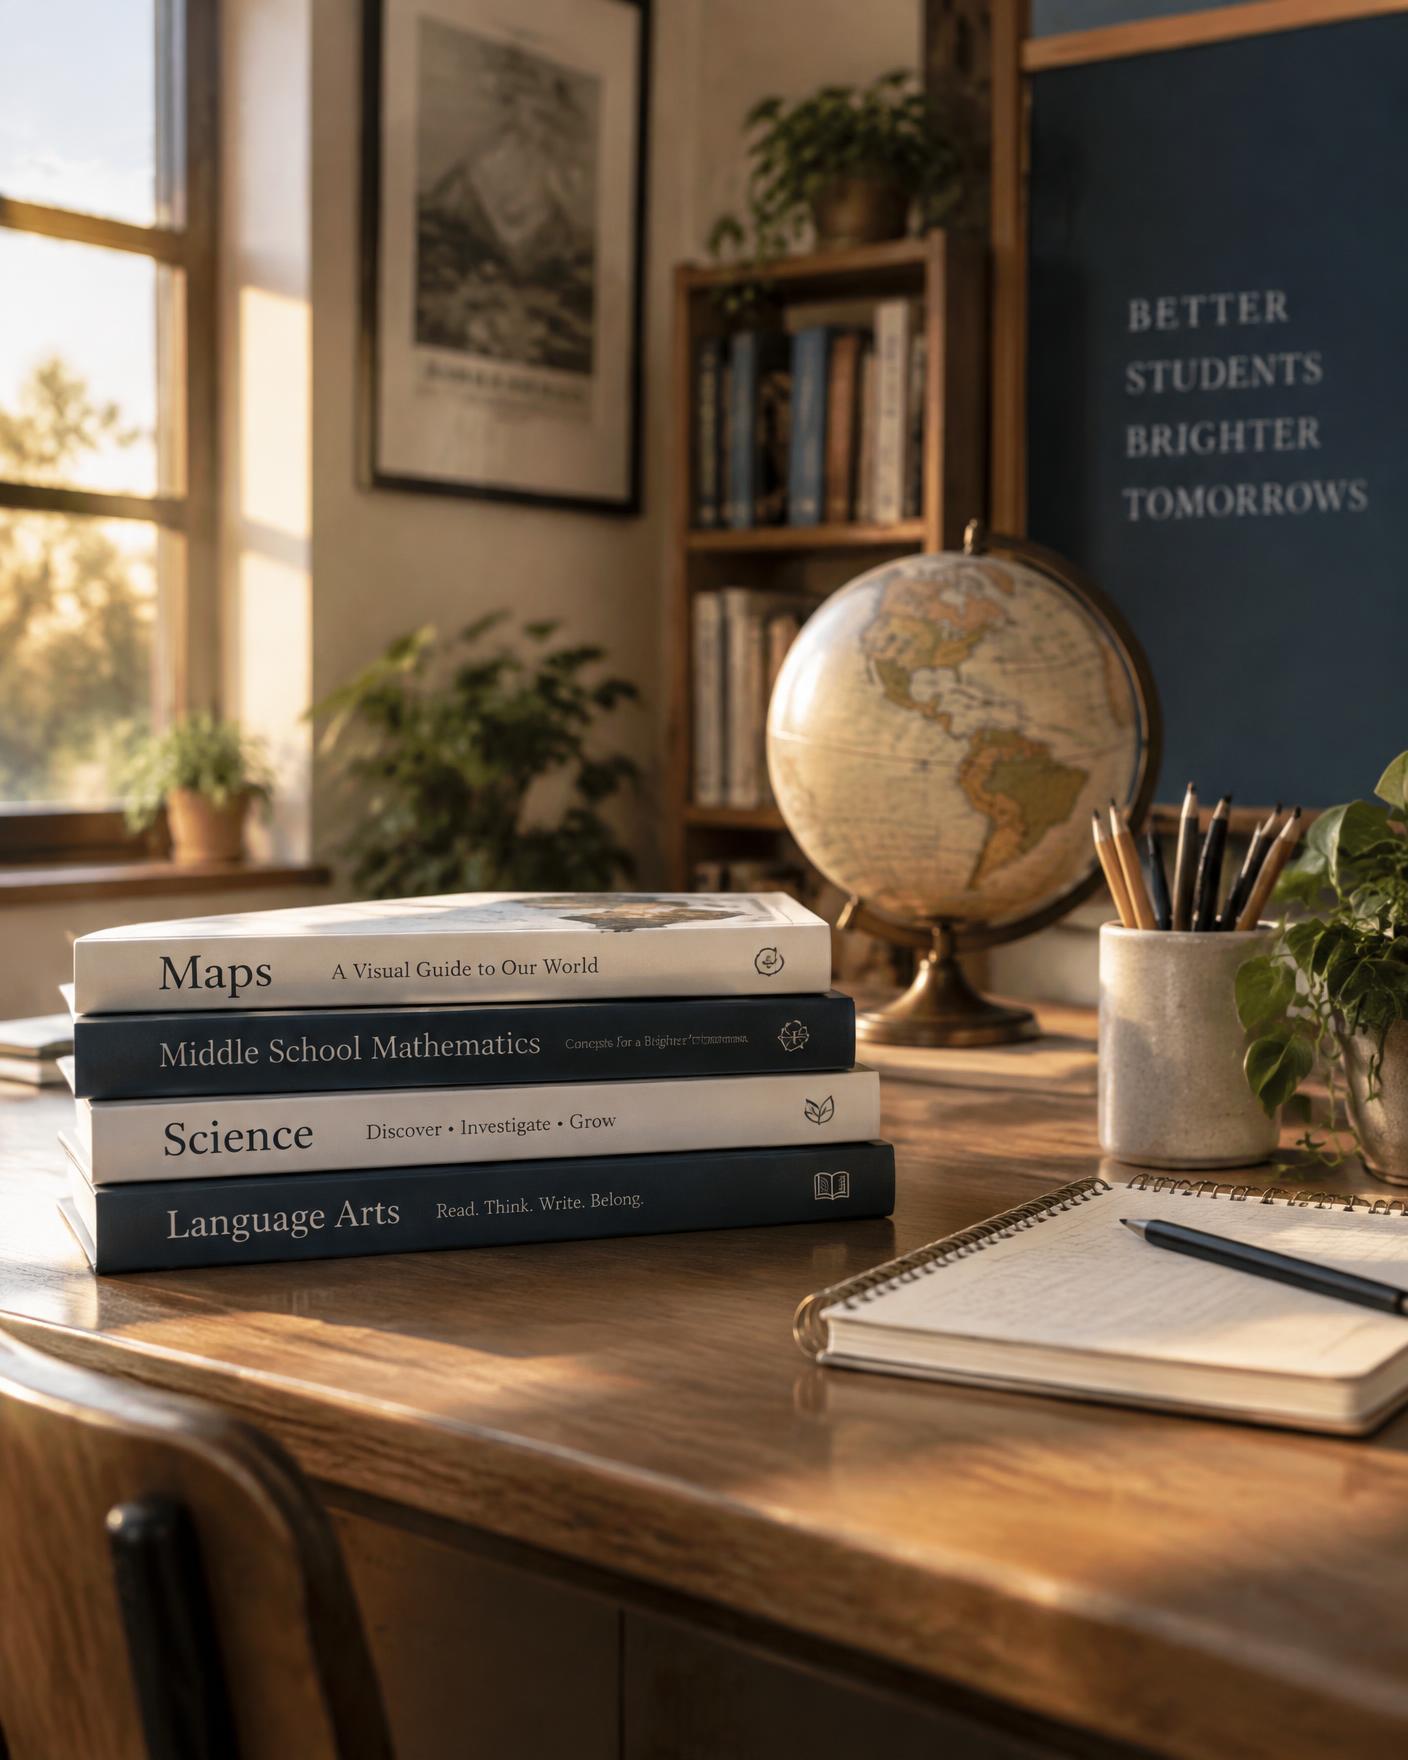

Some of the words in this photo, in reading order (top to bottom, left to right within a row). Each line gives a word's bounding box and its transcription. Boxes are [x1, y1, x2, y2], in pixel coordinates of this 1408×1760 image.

[1128, 290, 1289, 333] BETTER
[1125, 352, 1324, 395] STUDENTS
[1125, 416, 1321, 459] BRIGHTER
[1123, 479, 1369, 522] TOMORROWS
[159, 954, 272, 999] Maps
[331, 963, 347, 980] A
[353, 960, 410, 979] Visual
[416, 959, 471, 978] Guide
[477, 961, 496, 977] to
[502, 959, 537, 977] Our
[543, 955, 599, 975] World
[159, 1038, 259, 1069] Middle
[269, 1034, 363, 1064] School
[371, 1032, 541, 1059] Mathematics
[164, 1119, 314, 1157] Science
[366, 1123, 442, 1140] Discover
[460, 1117, 551, 1137] Investigate
[569, 1113, 617, 1131] Grow
[166, 1208, 326, 1244] Language
[334, 1199, 400, 1230] Arts
[436, 1200, 480, 1219] Read.
[483, 1197, 533, 1216] Think.
[537, 1194, 586, 1213] Write.
[590, 1191, 643, 1210] Belong.
